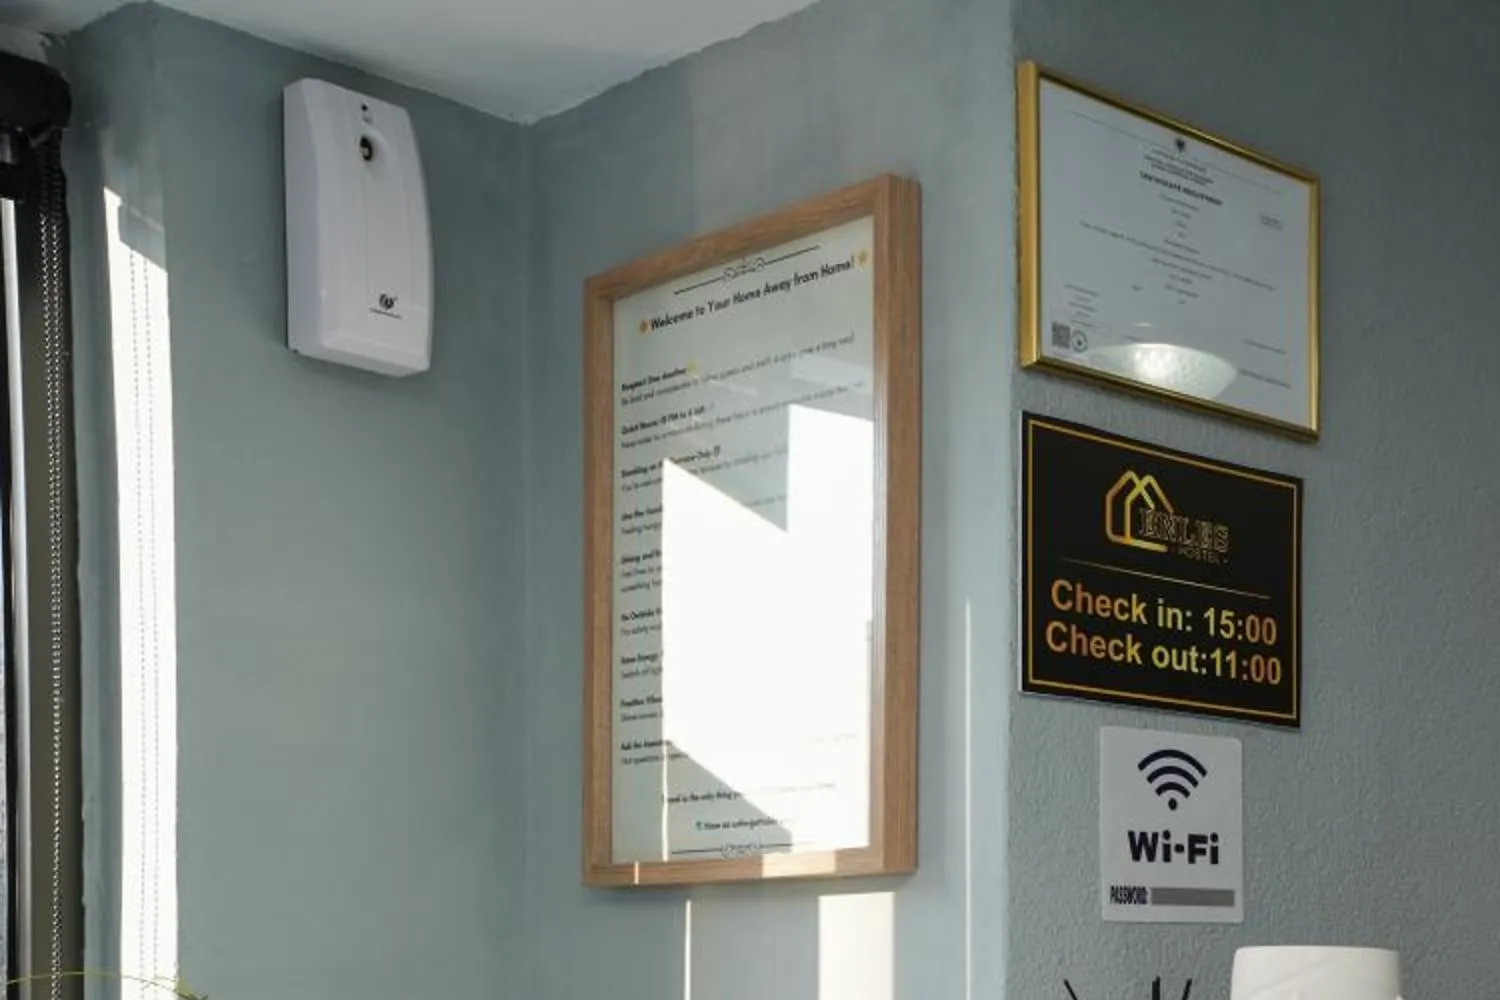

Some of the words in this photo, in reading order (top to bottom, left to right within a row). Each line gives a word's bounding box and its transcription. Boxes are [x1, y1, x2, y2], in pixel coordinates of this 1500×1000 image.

[651, 309, 693, 331] Welcome
[695, 304, 705, 316] to
[707, 298, 731, 313] Your
[733, 289, 761, 304] Home
[763, 280, 791, 297] Away
[794, 270, 819, 286] from
[1051, 578, 1148, 625] Check
[1157, 598, 1193, 632] in:
[1203, 606, 1277, 646] 15:00
[1045, 620, 1143, 666] Check
[1127, 829, 1220, 865] Wi-Fi
